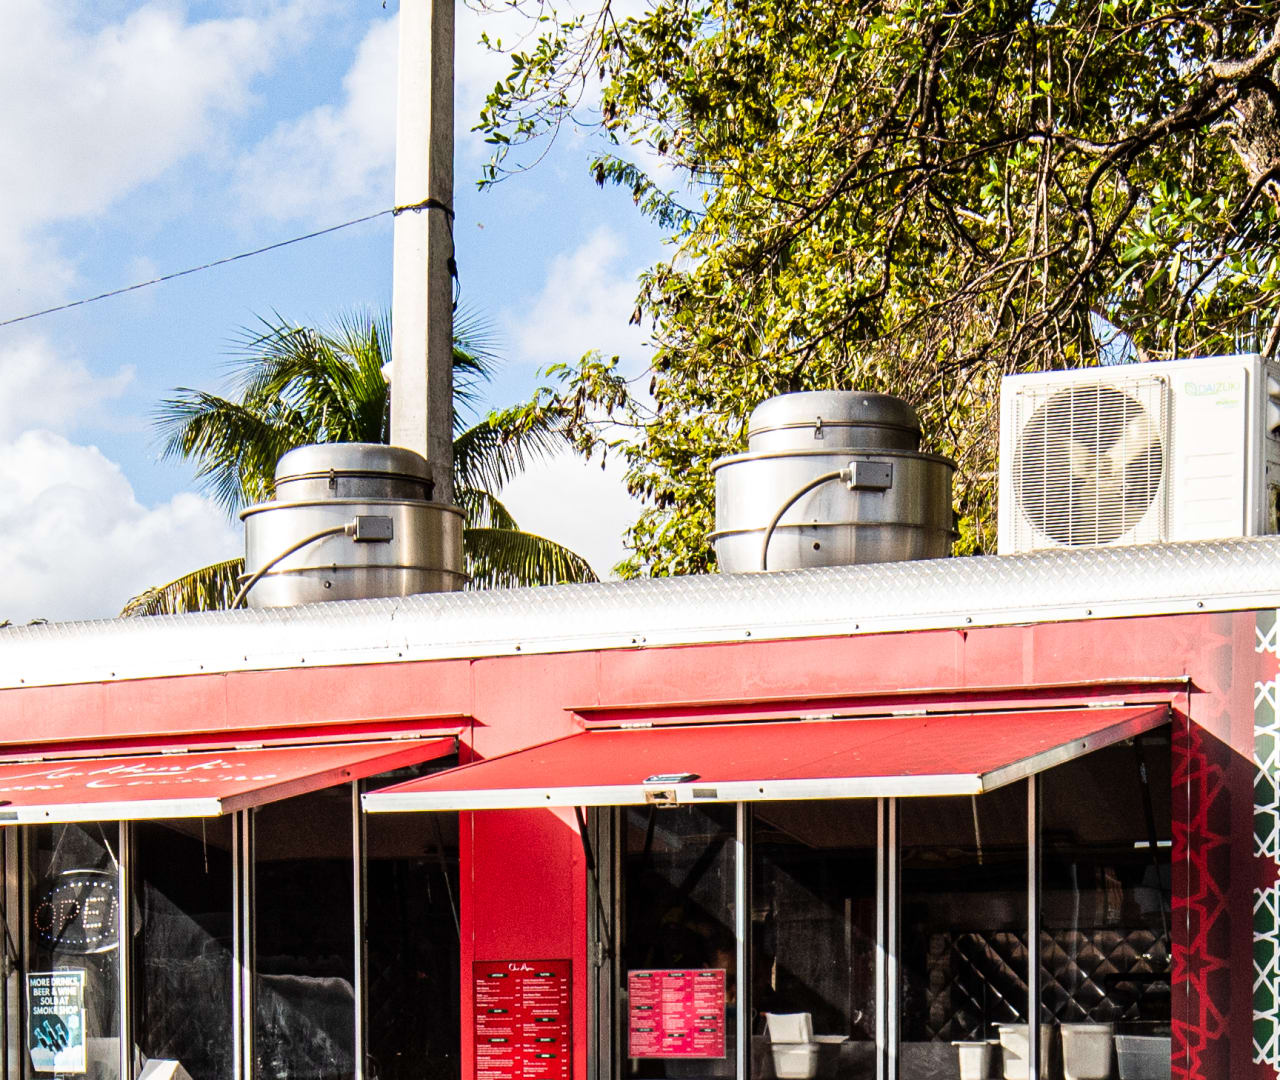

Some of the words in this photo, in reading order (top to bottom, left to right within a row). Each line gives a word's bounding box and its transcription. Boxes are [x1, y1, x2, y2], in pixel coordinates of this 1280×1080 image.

[30, 978, 50, 987] MORE
[33, 987, 50, 996] BEER
[58, 986, 77, 996] WINE
[40, 996, 58, 1005] SOLD
[59, 996, 70, 1005] AT
[33, 1005, 57, 1015] SMOKE
[58, 1005, 78, 1015] SHOP
